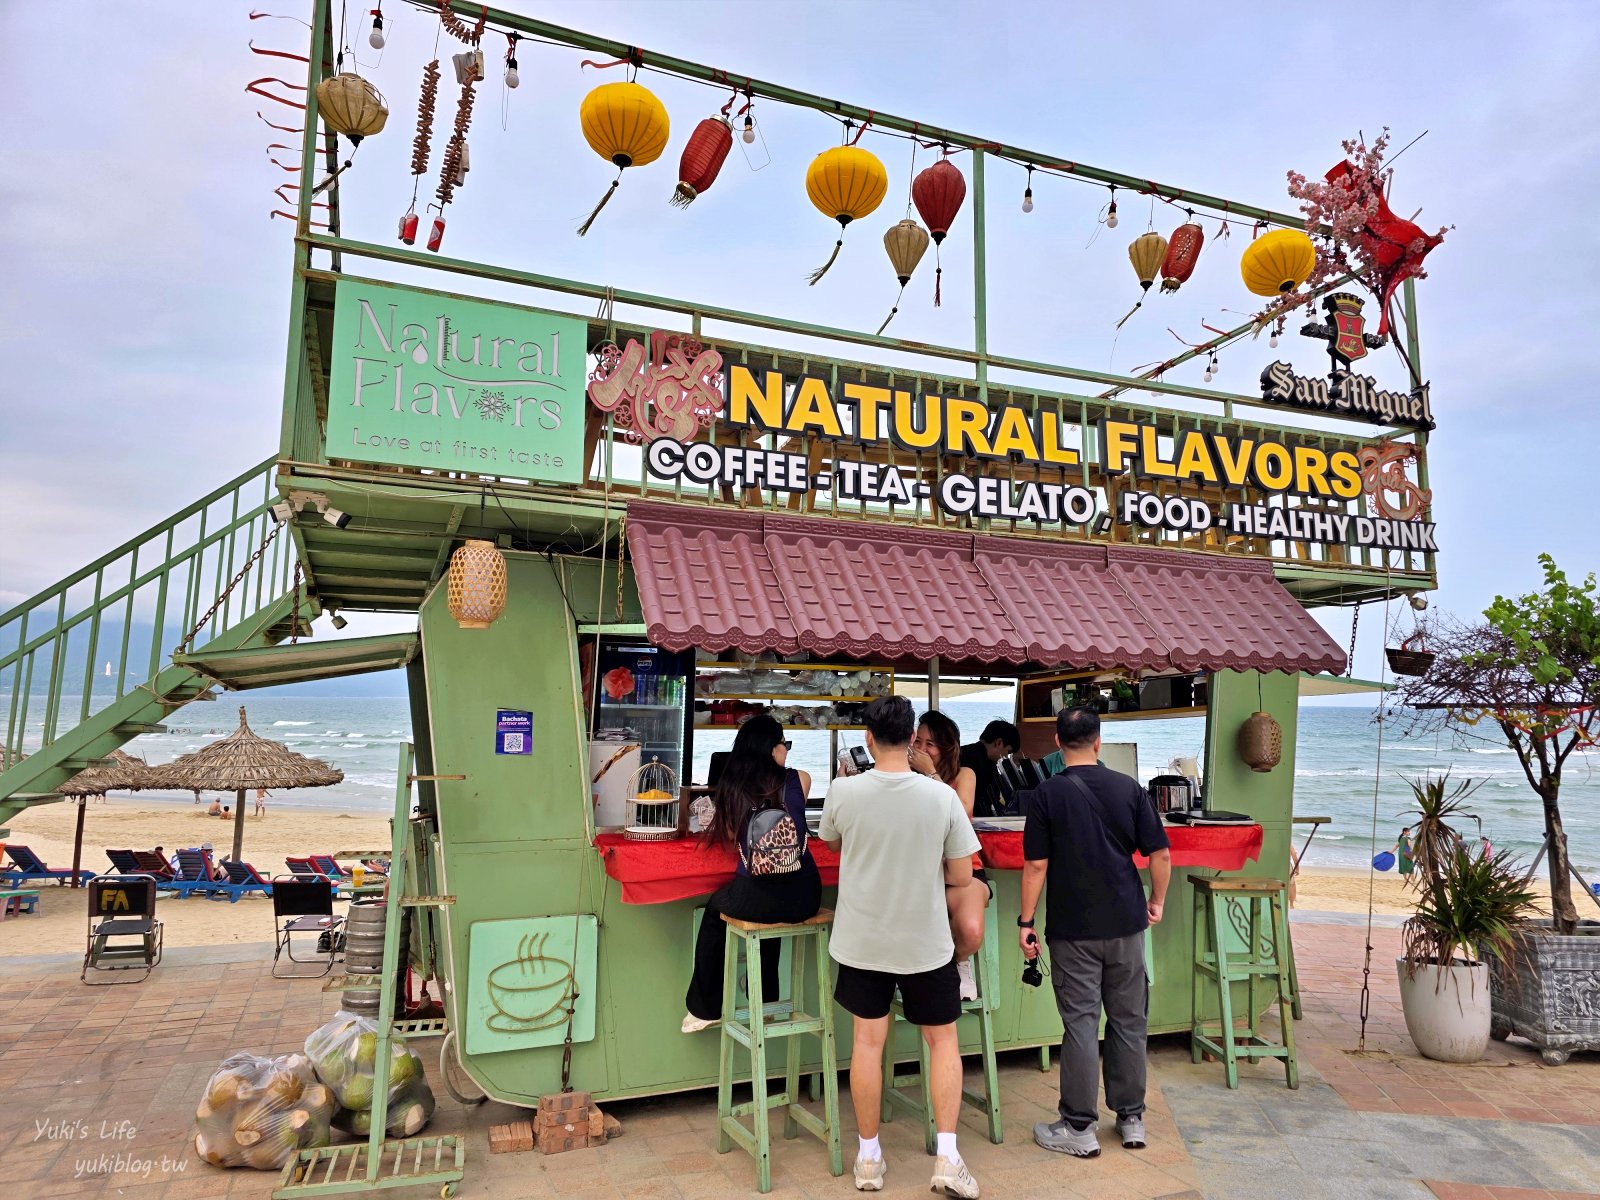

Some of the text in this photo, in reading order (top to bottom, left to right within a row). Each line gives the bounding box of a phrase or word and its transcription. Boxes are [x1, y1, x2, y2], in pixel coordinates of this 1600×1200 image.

[354, 298, 562, 379] Natural
[1266, 360, 1435, 424] San Miguel
[353, 428, 565, 469] Love at first taste
[726, 362, 1363, 500] NATURAL FLAVORS
[648, 438, 808, 491] COFFEE
[838, 460, 910, 502] TEA
[1123, 492, 1212, 530] FOOD
[1231, 503, 1351, 543] HEALTHY
[1356, 516, 1437, 551] DRINK
[101, 889, 130, 911] FA
